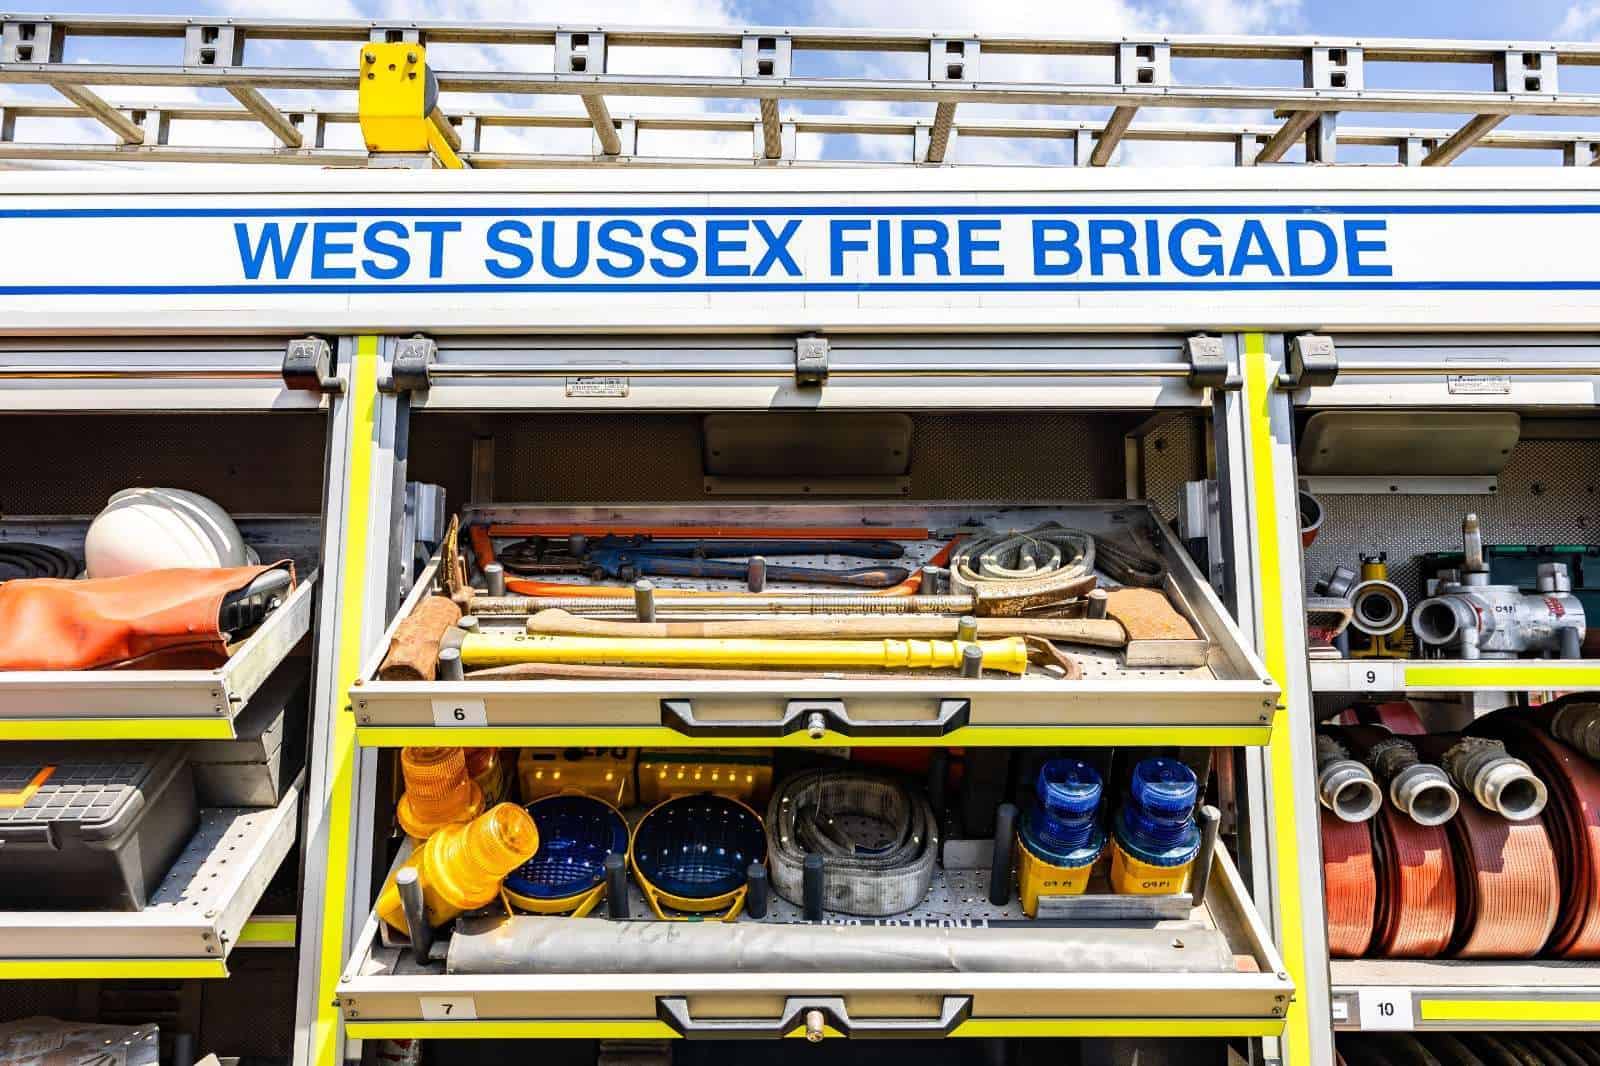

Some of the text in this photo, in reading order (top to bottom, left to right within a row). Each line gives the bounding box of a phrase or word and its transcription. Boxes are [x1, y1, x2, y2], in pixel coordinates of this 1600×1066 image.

[235, 218, 1392, 280] WEST SUSSEX FIRE BRIGADE
[1366, 670, 1376, 684] 9
[453, 707, 465, 721] 6
[441, 1003, 453, 1015] 7
[1377, 1002, 1394, 1017] 10
